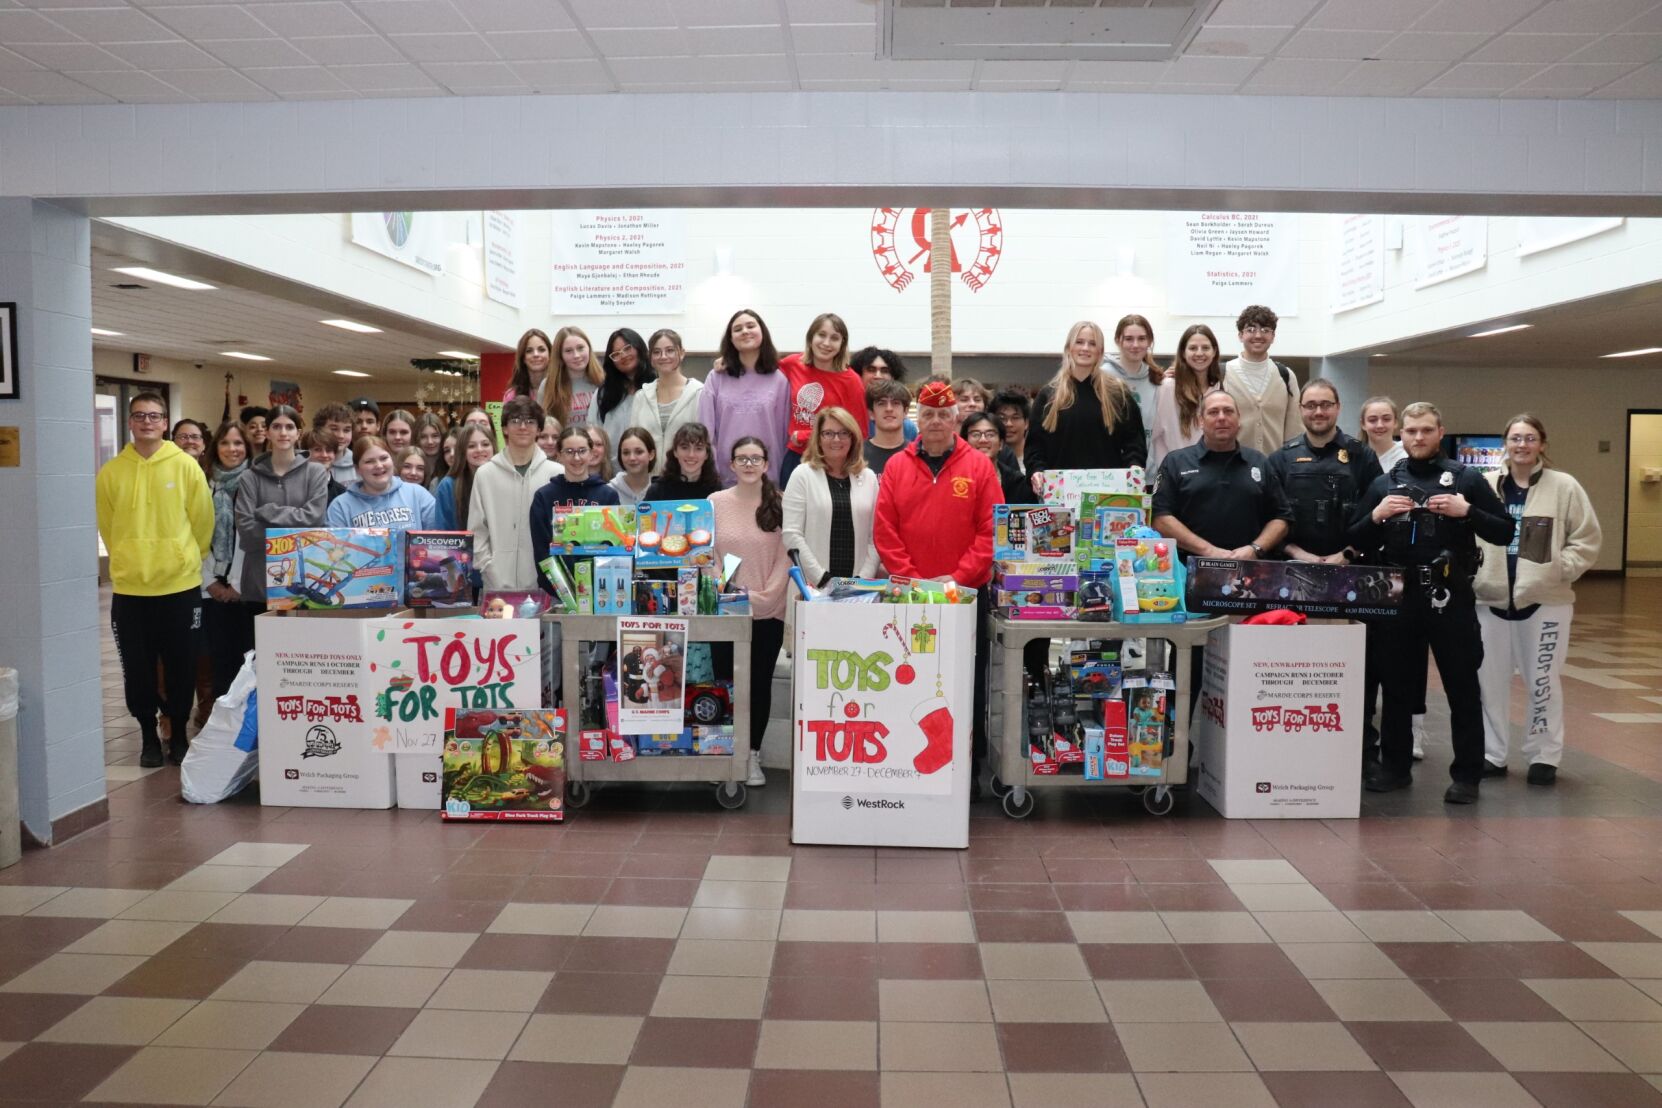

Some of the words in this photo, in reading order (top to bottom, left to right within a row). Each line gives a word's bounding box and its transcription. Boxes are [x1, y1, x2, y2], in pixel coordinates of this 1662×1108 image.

[1030, 508, 1048, 519] TECH
[1034, 516, 1052, 526] DECK
[1203, 600, 1244, 608] MICROSCOPE
[1304, 605, 1338, 613] TELESCOPE
[402, 634, 517, 685] TOYS
[807, 649, 894, 692] TOYS
[279, 700, 302, 712] TOYS
[307, 702, 325, 714] FOR
[331, 704, 356, 716] TOTS
[385, 685, 439, 722] FOR
[450, 682, 515, 708] TOTS
[1254, 710, 1279, 723] TOYS
[1284, 712, 1304, 724] FOR
[1310, 713, 1336, 725] TOTS
[396, 728, 417, 748] Nov
[422, 734, 436, 746] 27
[808, 720, 890, 764] TOTS
[857, 799, 905, 809] WestRock
